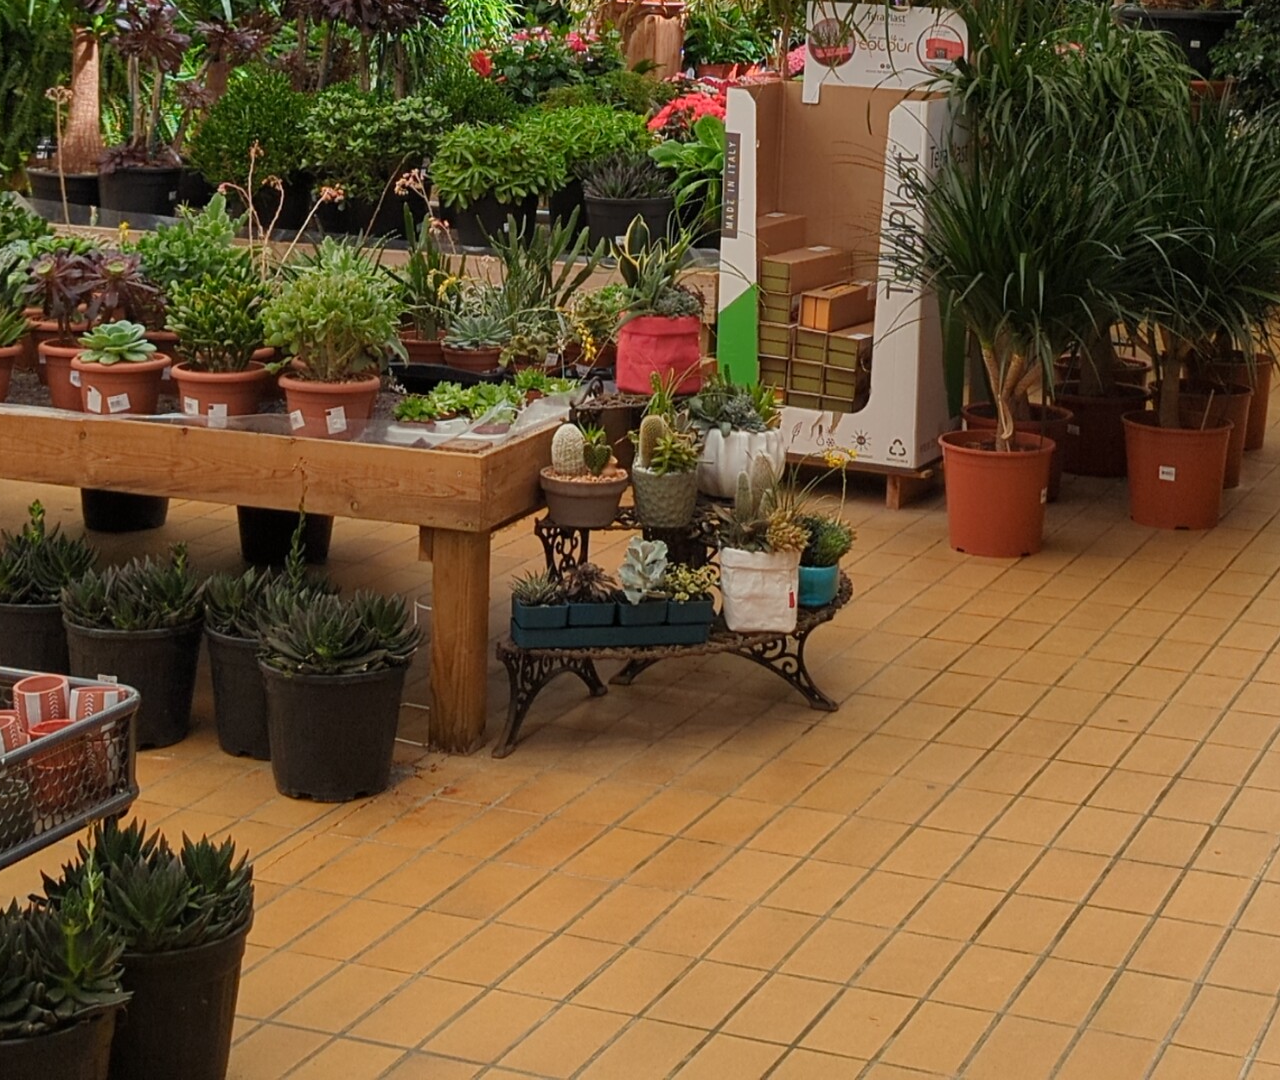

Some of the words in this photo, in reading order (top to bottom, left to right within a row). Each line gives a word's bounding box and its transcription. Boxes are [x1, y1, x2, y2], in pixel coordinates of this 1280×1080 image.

[867, 10, 906, 23] Tralast
[728, 141, 737, 174] ITALY
[930, 142, 969, 170] Teralast
[727, 181, 735, 192] IN
[726, 199, 736, 230] MADE
